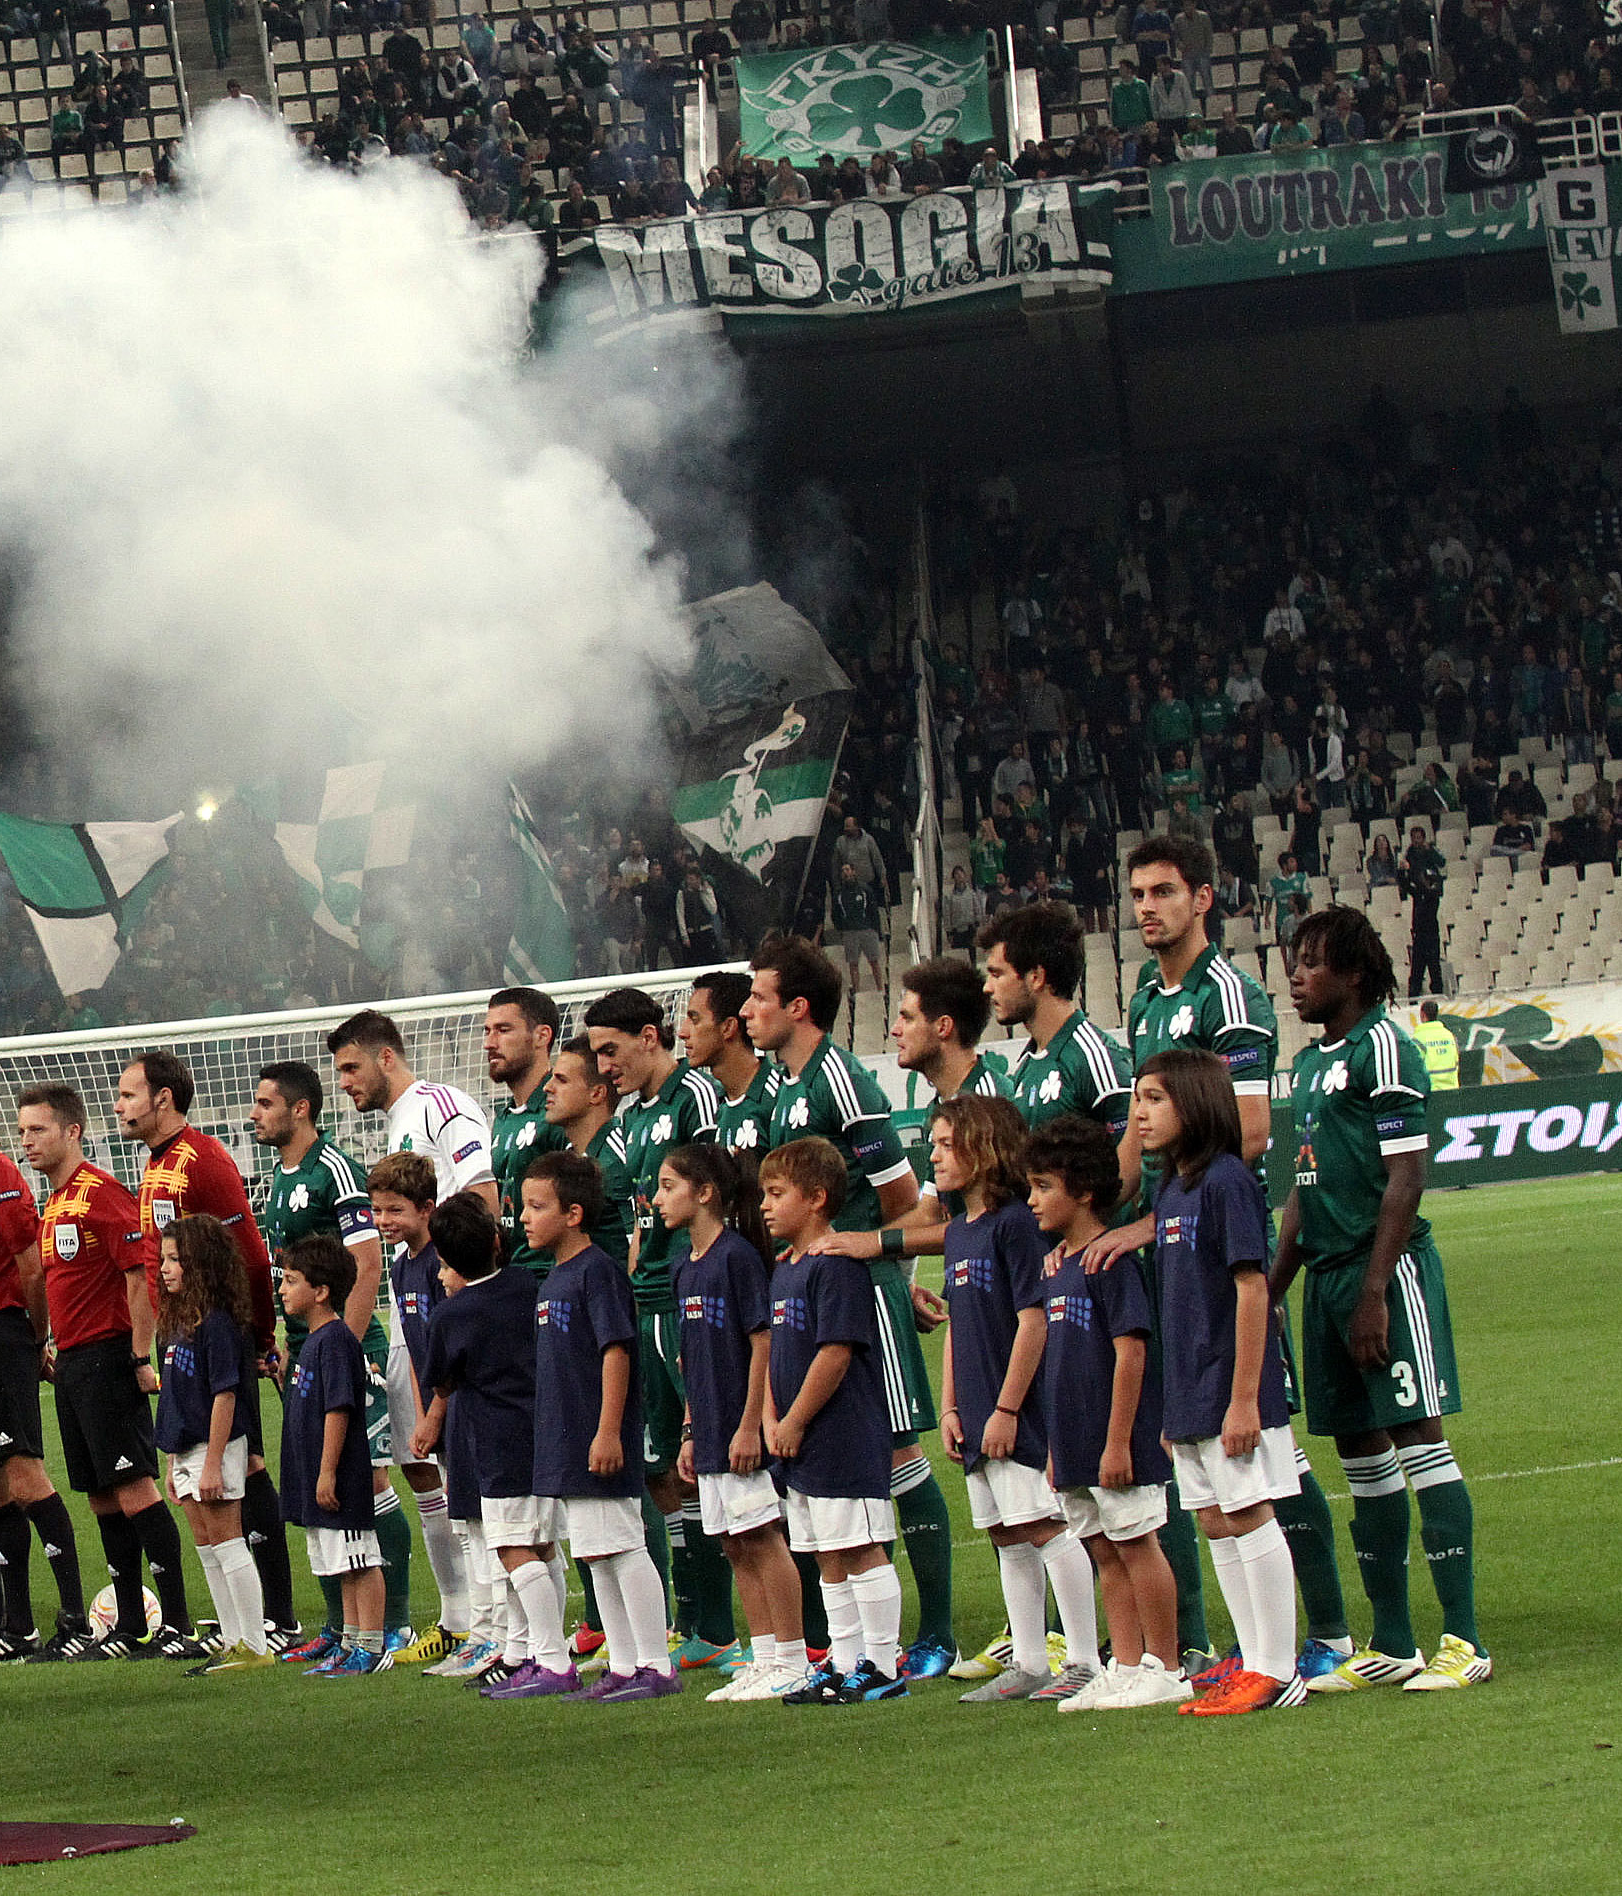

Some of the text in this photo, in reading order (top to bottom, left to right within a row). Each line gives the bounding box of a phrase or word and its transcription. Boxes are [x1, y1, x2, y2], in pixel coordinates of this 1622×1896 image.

[1166, 152, 1446, 247] LOUTRAKI
[1557, 181, 1597, 221] G
[594, 182, 1082, 318] MESOGIA
[880, 232, 1042, 311] gate 13
[58, 1237, 76, 1247] FIFA
[1390, 1360, 1418, 1408] 3
